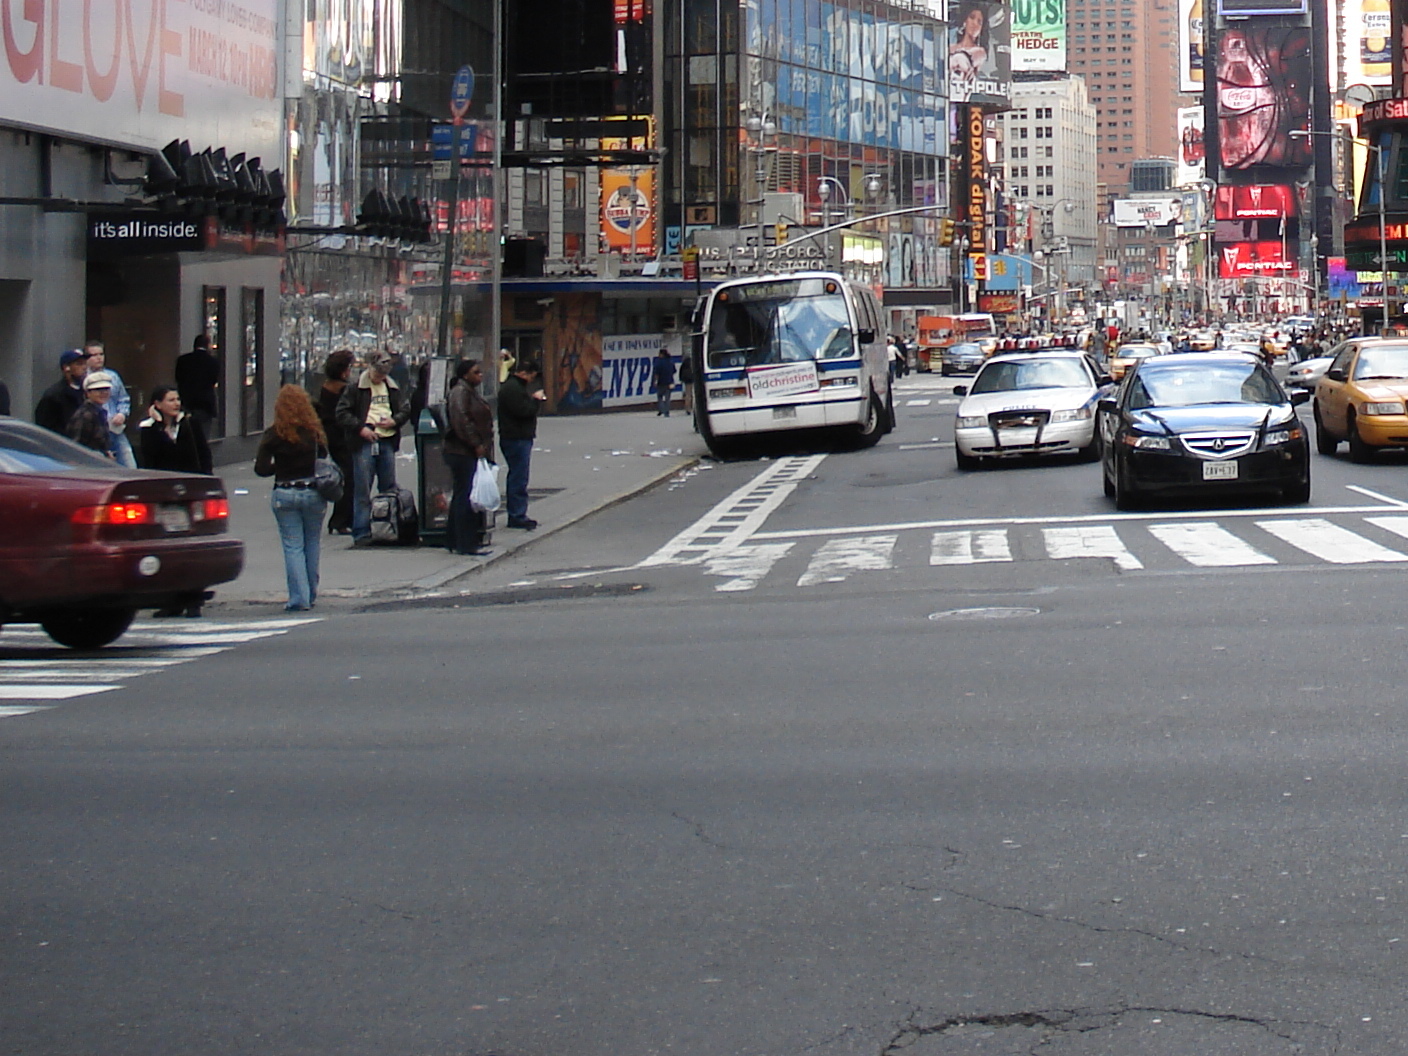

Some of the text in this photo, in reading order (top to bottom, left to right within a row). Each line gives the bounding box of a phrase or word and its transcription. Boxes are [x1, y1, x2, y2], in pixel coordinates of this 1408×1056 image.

[1017, 38, 1059, 50] HEDGE
[970, 107, 983, 179] KODAK
[969, 184, 984, 248] digital
[118, 221, 140, 237] all
[1236, 262, 1293, 270] PONTIAC
